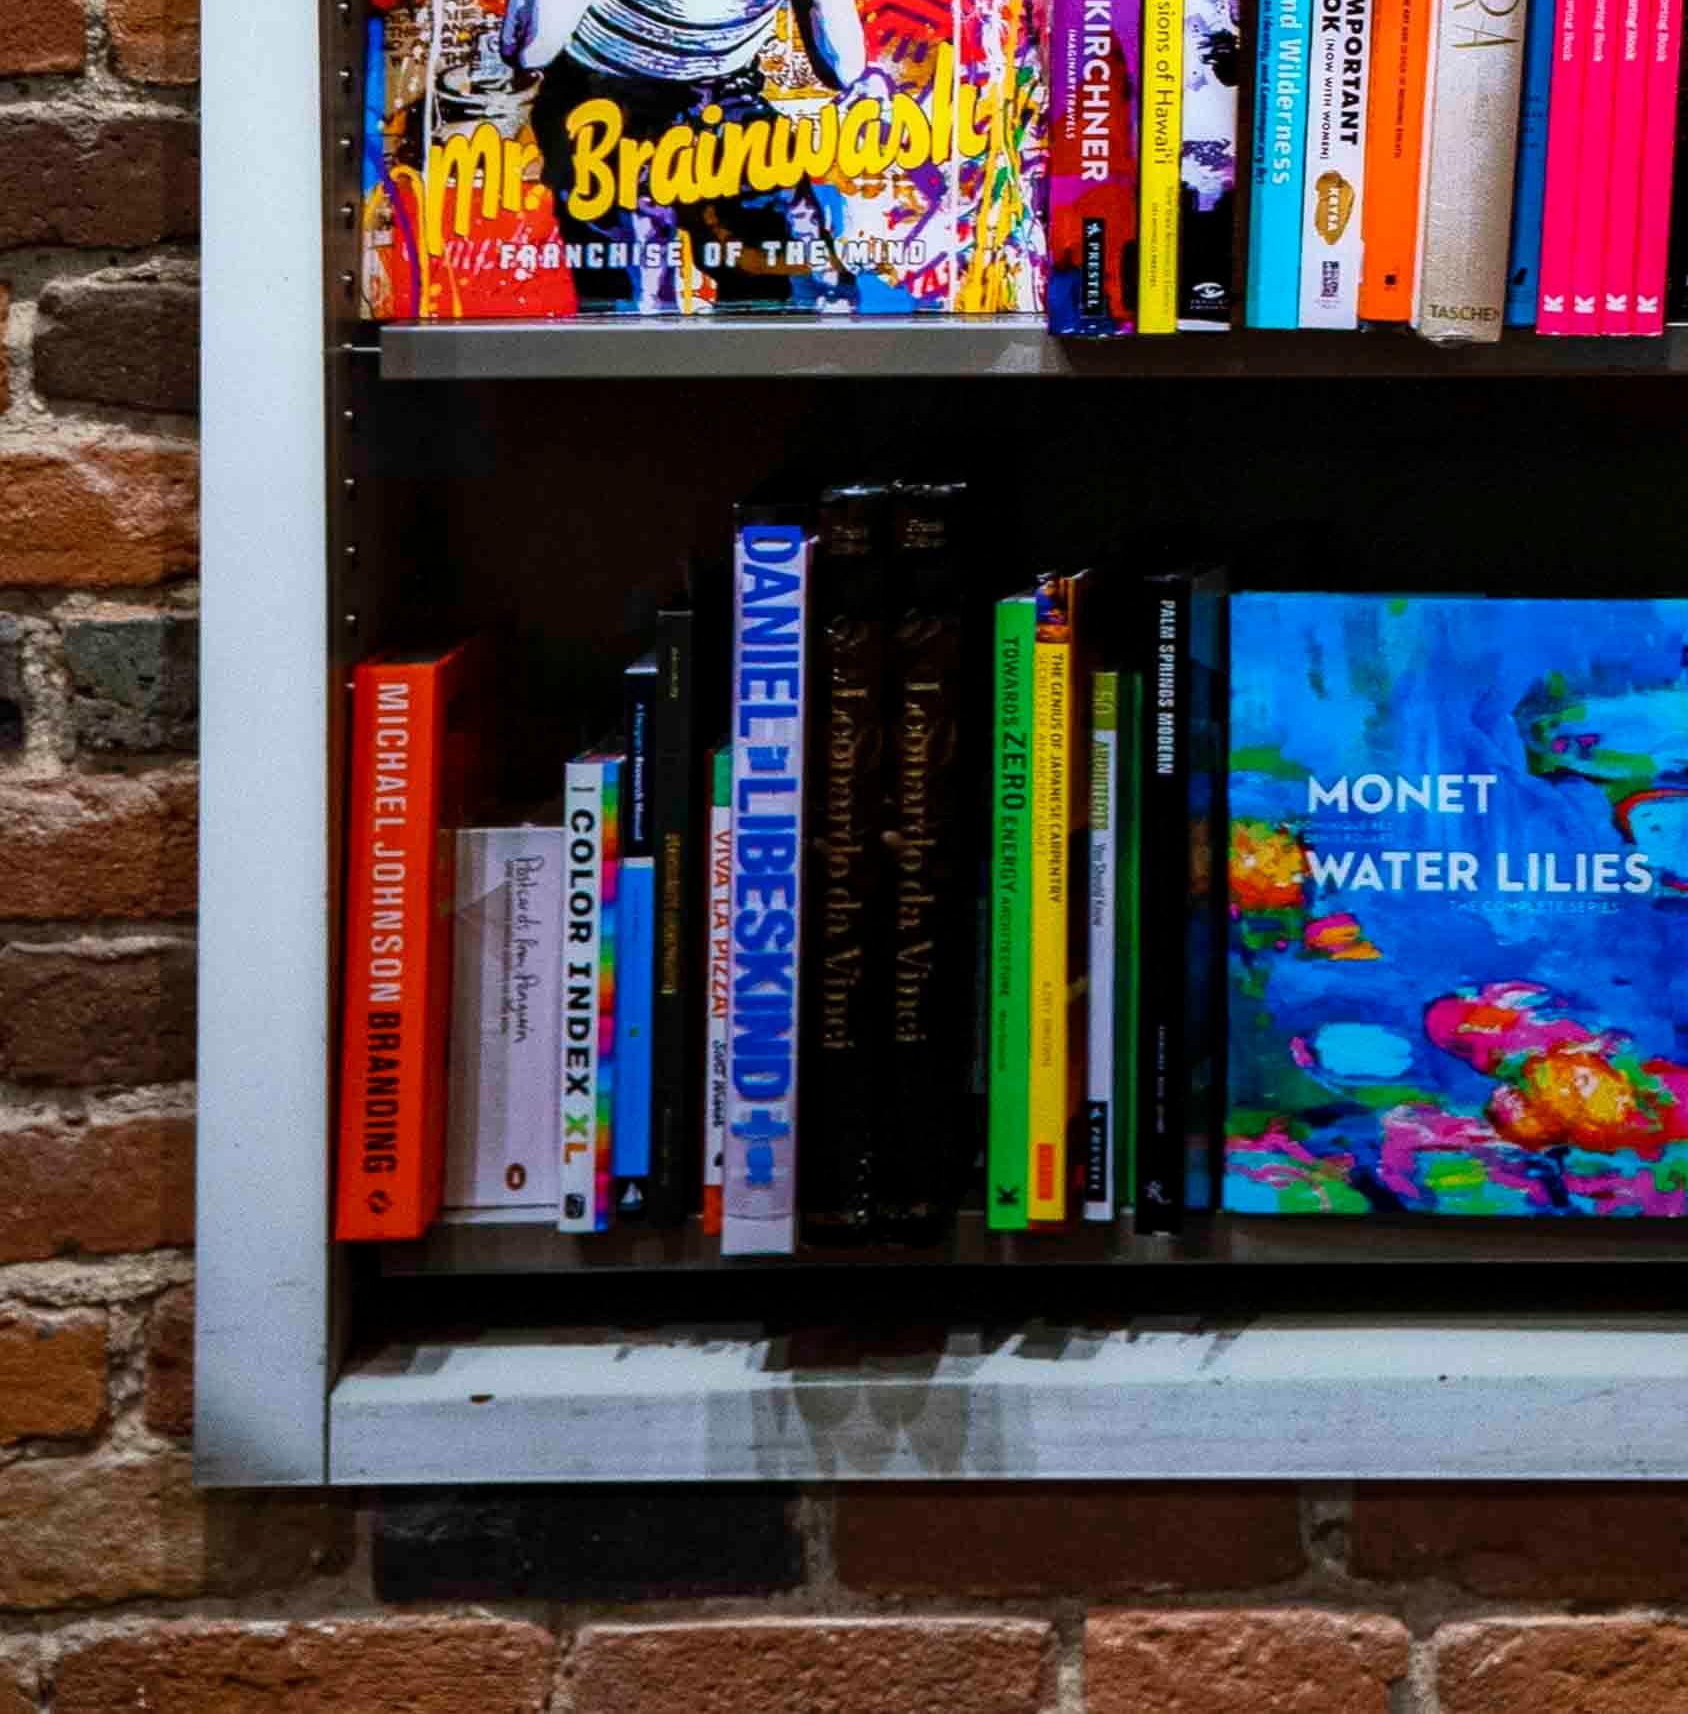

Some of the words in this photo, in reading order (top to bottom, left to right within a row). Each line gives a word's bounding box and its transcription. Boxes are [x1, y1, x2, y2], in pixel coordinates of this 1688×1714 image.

[565, 40, 989, 220] Brainwash
[1273, 38, 1304, 184] Wilderness
[500, 243, 684, 268] FRANCHISE
[704, 243, 742, 267] OF
[762, 243, 826, 267] THE
[834, 243, 925, 268] MIND
[740, 524, 807, 738] DANIEL
[375, 682, 410, 832] MICHAEL
[1306, 773, 1499, 816] MONET
[369, 840, 406, 1003] JOHNSON
[568, 808, 595, 946] COLOR
[734, 772, 800, 1104] LIBESKIND
[1305, 850, 1477, 892] WATER
[1496, 853, 1653, 895] LILIES
[363, 1010, 401, 1175] BRANDING
[565, 961, 593, 1097] INDEX
[562, 1111, 589, 1166] XL
